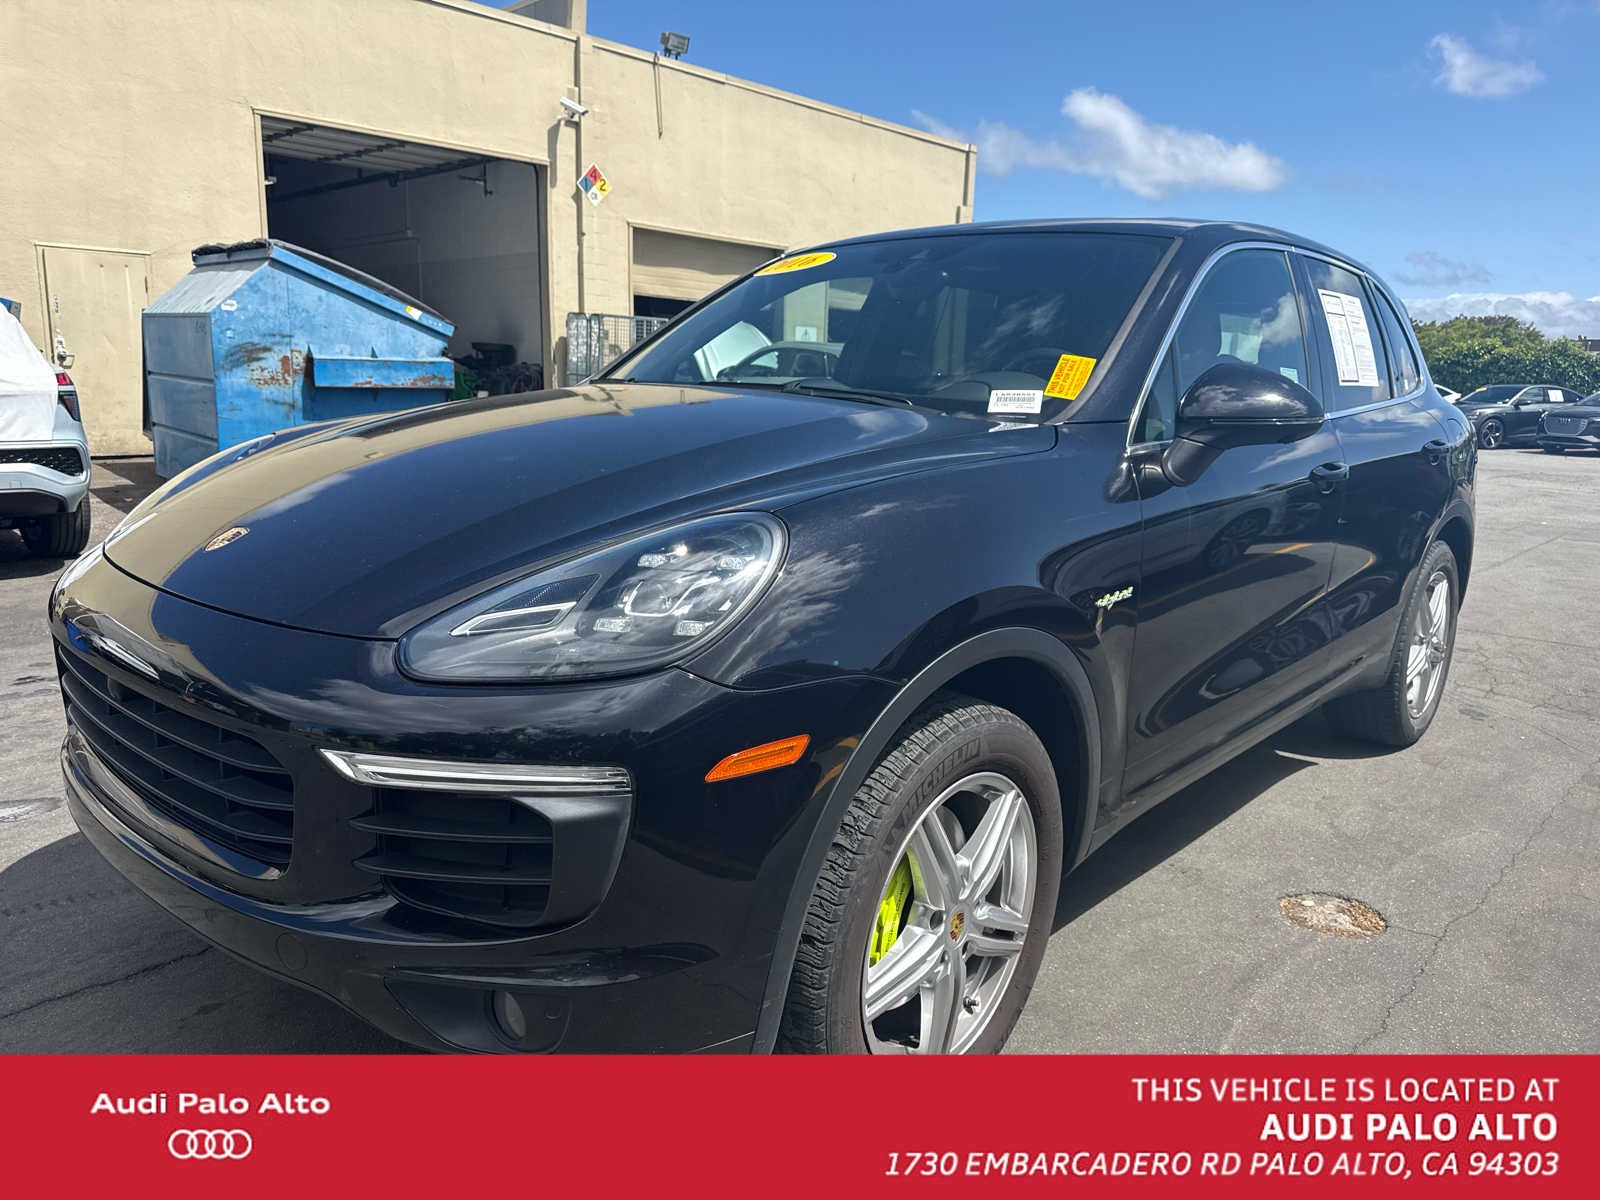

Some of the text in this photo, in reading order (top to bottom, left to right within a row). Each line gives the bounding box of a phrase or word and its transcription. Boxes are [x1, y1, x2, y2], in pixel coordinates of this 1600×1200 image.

[590, 169, 598, 182] 4
[599, 178, 607, 192] 2
[904, 737, 981, 820] MICHELIN
